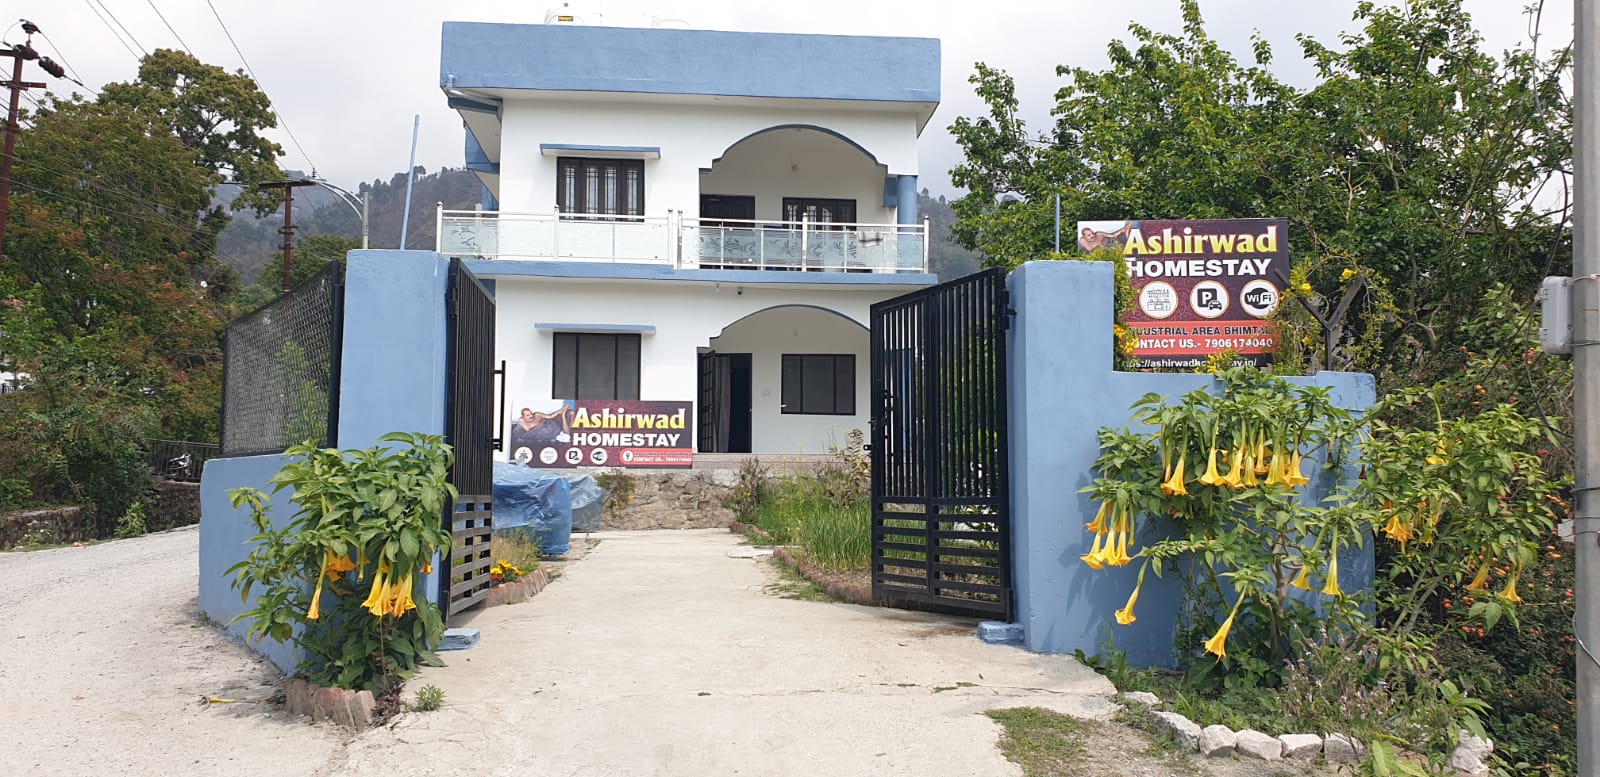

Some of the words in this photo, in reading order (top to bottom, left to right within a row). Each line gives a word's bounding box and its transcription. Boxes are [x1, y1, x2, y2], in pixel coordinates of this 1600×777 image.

[1123, 225, 1278, 255] Ashirwad
[1126, 258, 1272, 277] HOMESTAY
[1192, 326, 1221, 335] AREA
[571, 408, 686, 430] Ashirwad
[573, 433, 681, 447] HOMESTAY
